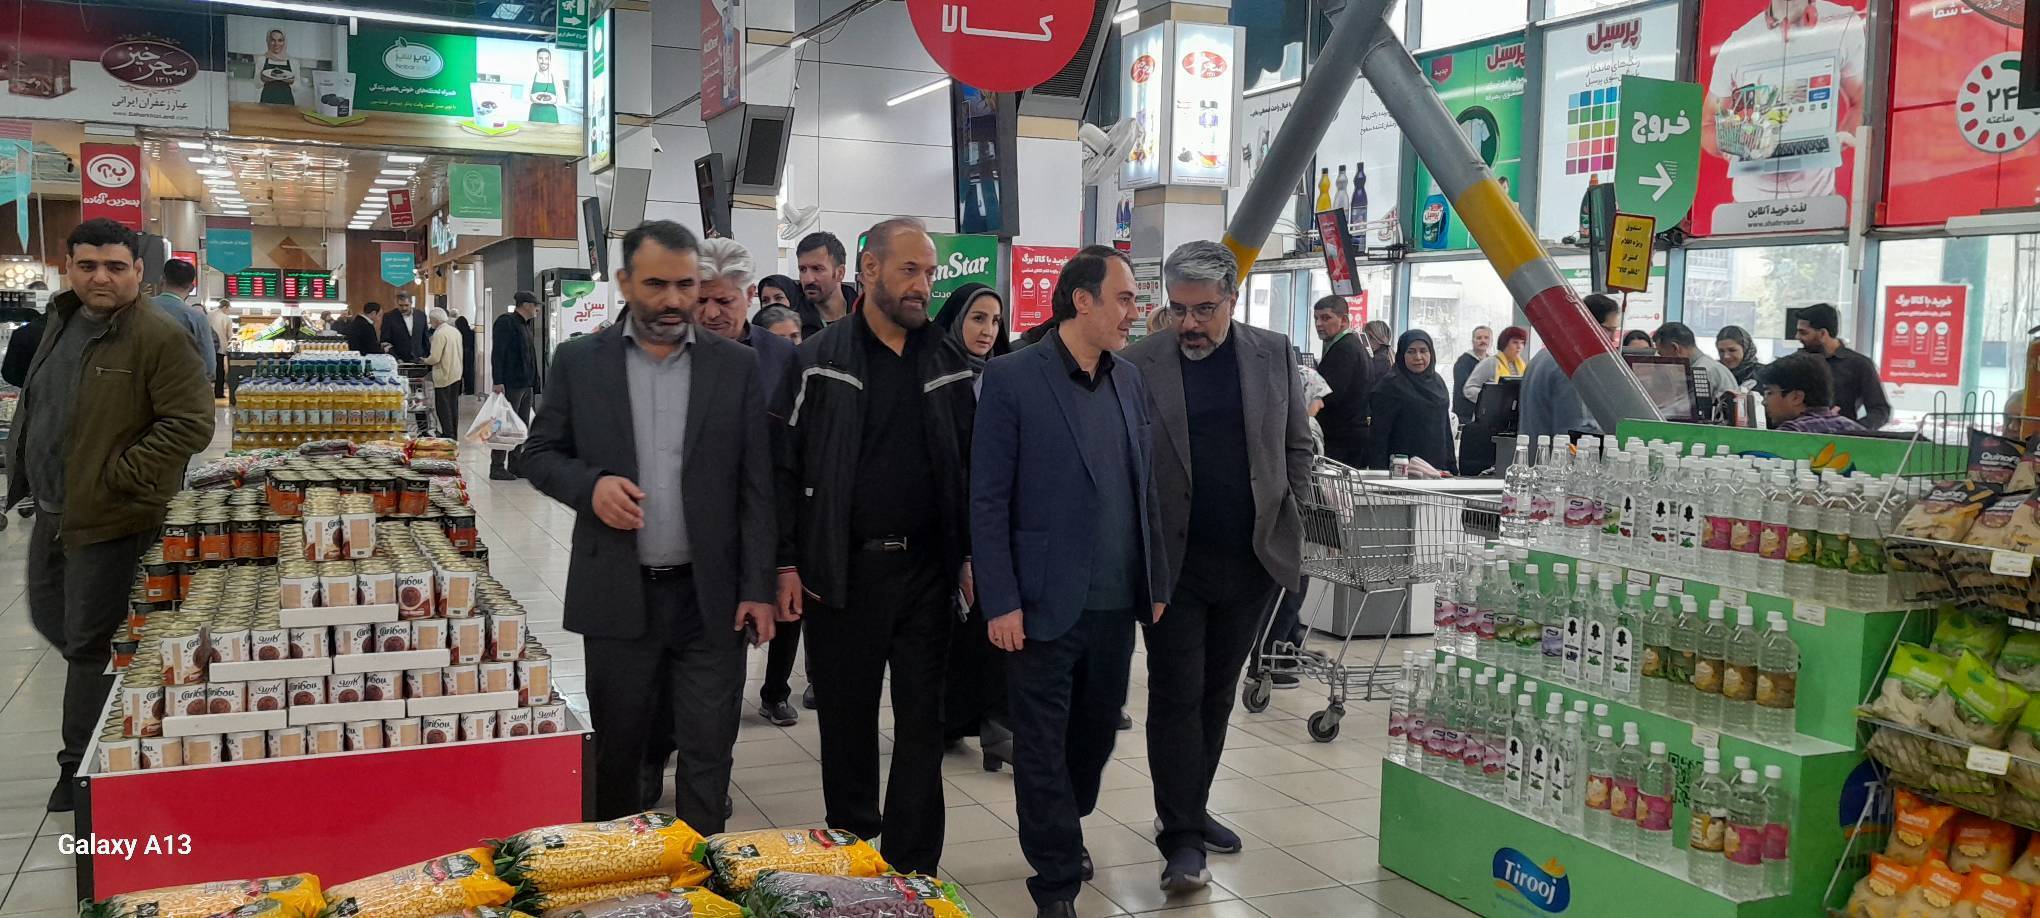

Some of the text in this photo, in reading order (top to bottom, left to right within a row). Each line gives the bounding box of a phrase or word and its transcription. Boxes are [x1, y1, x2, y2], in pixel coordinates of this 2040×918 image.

[942, 4, 1053, 41] کالا
[1586, 18, 1641, 52] پرسیل
[112, 96, 138, 108] ایرانی
[1987, 86, 2019, 112] ۲۴
[1986, 113, 2014, 124] ساعته
[1631, 110, 1691, 144] خروج
[1748, 205, 1770, 218] آنلاین
[1770, 204, 1789, 216] خرید
[584, 302, 604, 311] سن
[574, 311, 591, 322] ایچ
[1504, 859, 1557, 904] Tirooj
